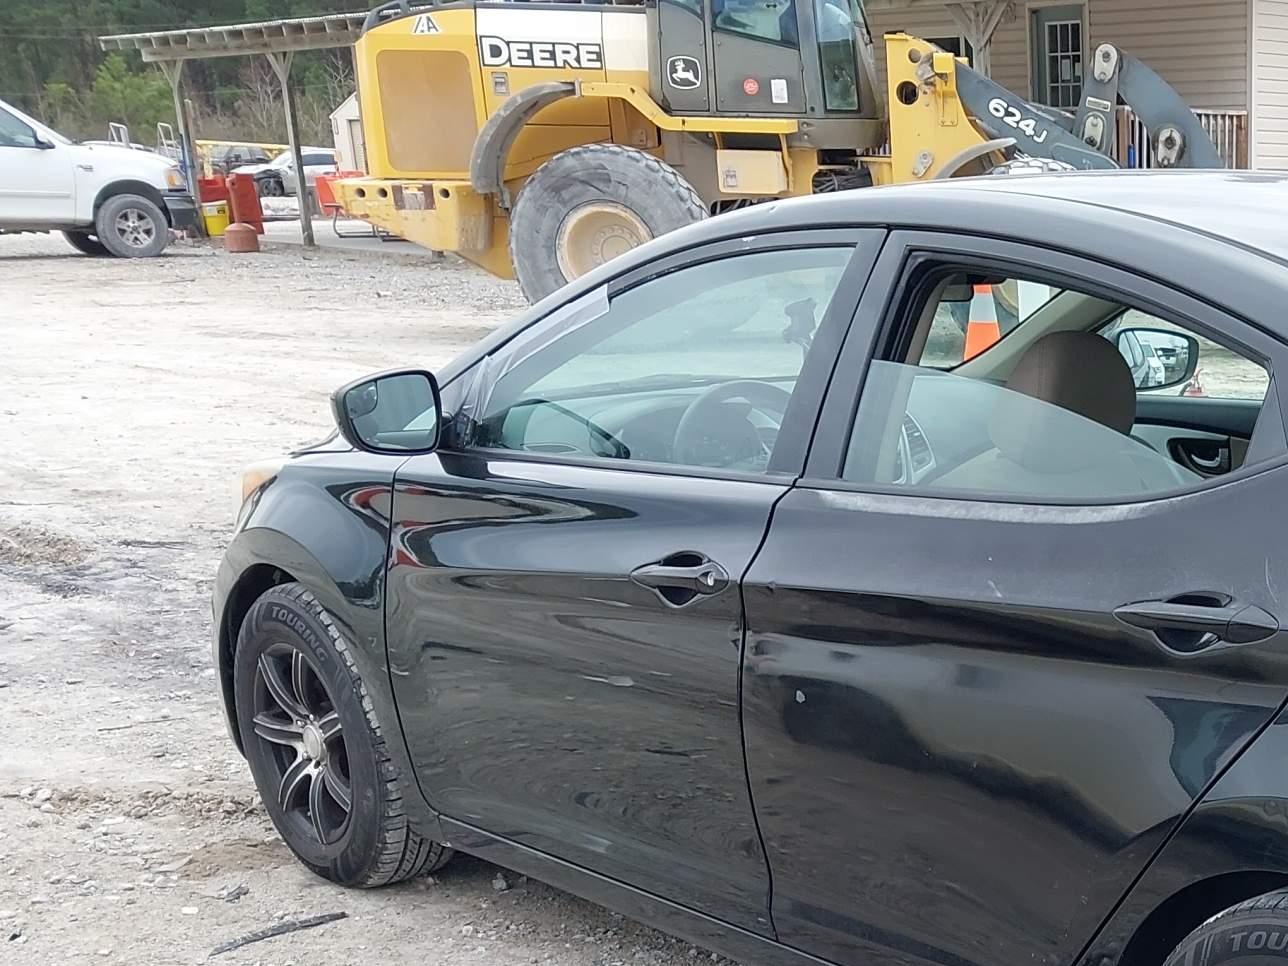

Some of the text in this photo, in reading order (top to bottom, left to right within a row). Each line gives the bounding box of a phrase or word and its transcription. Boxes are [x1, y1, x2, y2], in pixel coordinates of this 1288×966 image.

[480, 35, 603, 69] DEERE
[988, 98, 1048, 143] 624J
[271, 606, 329, 661] TOURING
